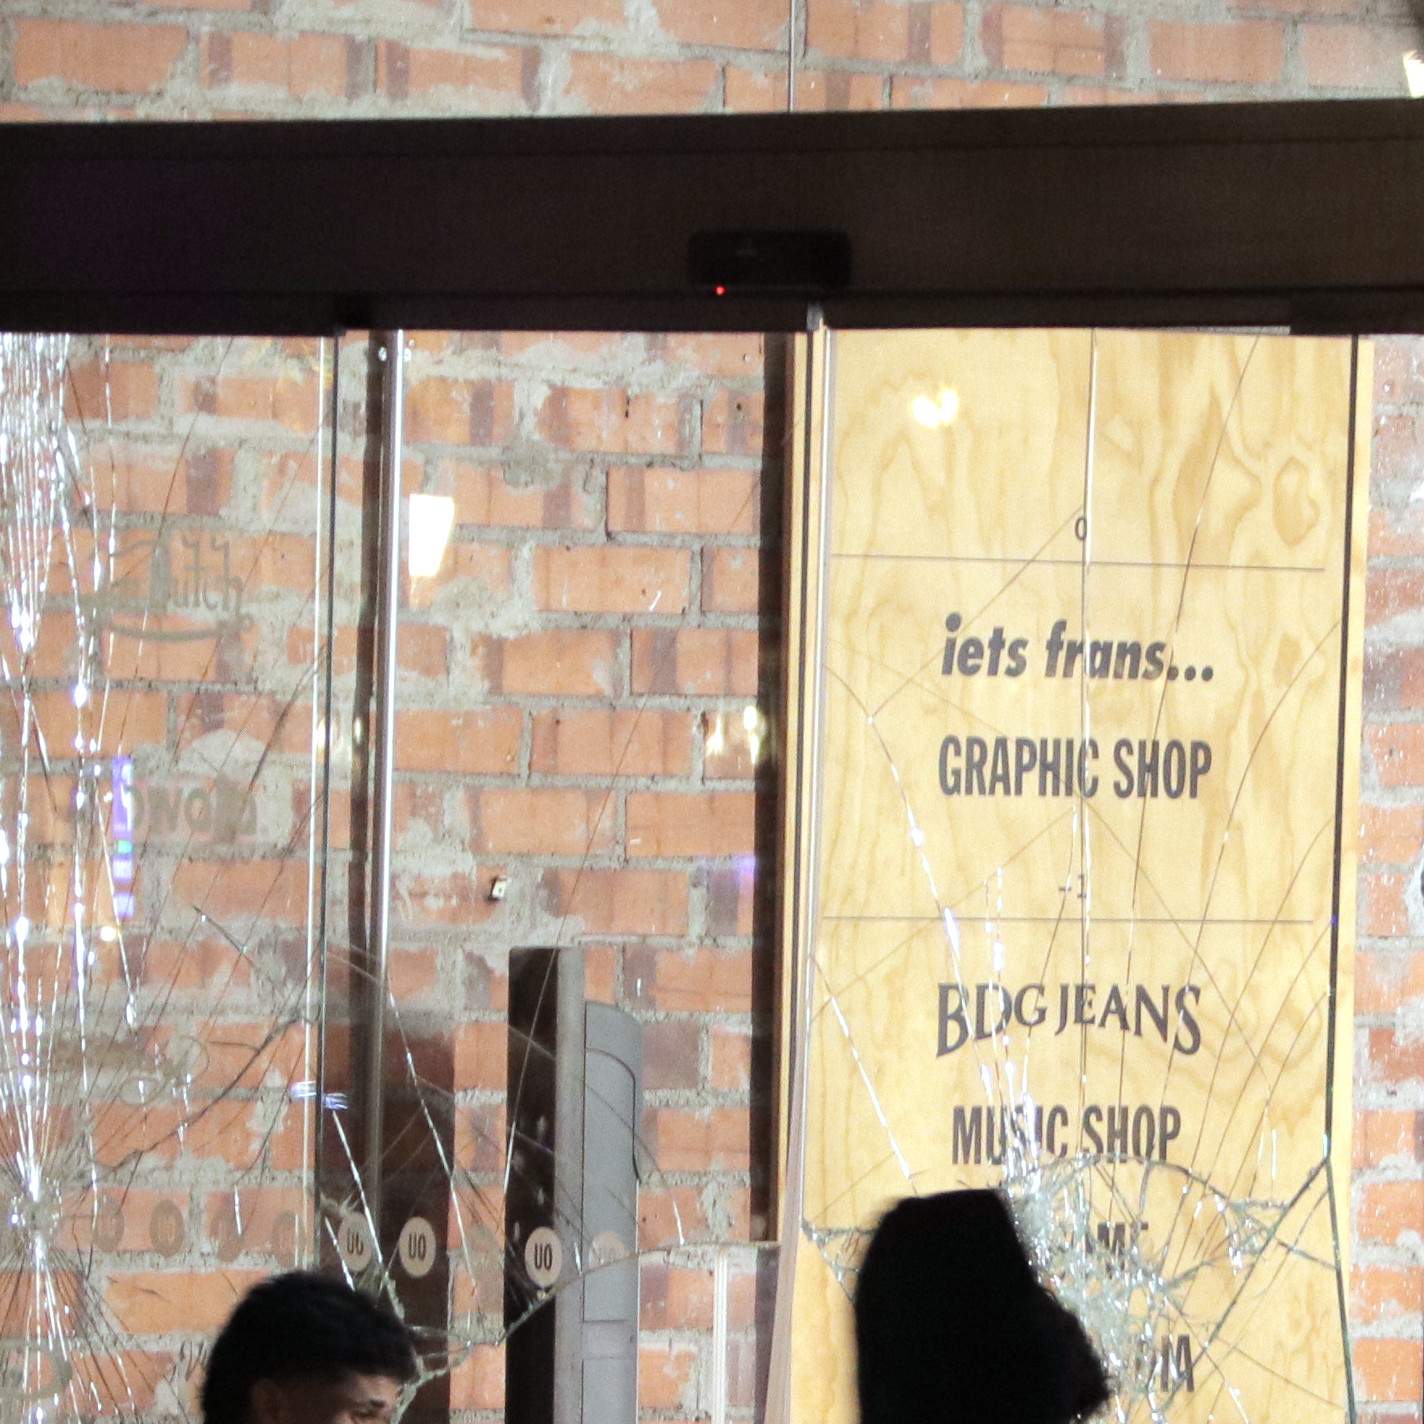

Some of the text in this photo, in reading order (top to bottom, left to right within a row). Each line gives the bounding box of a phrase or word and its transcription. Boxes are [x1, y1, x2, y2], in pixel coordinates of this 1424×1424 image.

[941, 612, 1215, 683] iets frans...
[939, 735, 1212, 799] GRAPHIC SHOP
[936, 981, 1201, 1058] BDG JEANS
[952, 1105, 1181, 1167] MUSIC SHOP
[409, 1232, 426, 1259] UO
[535, 1243, 552, 1270] UO
